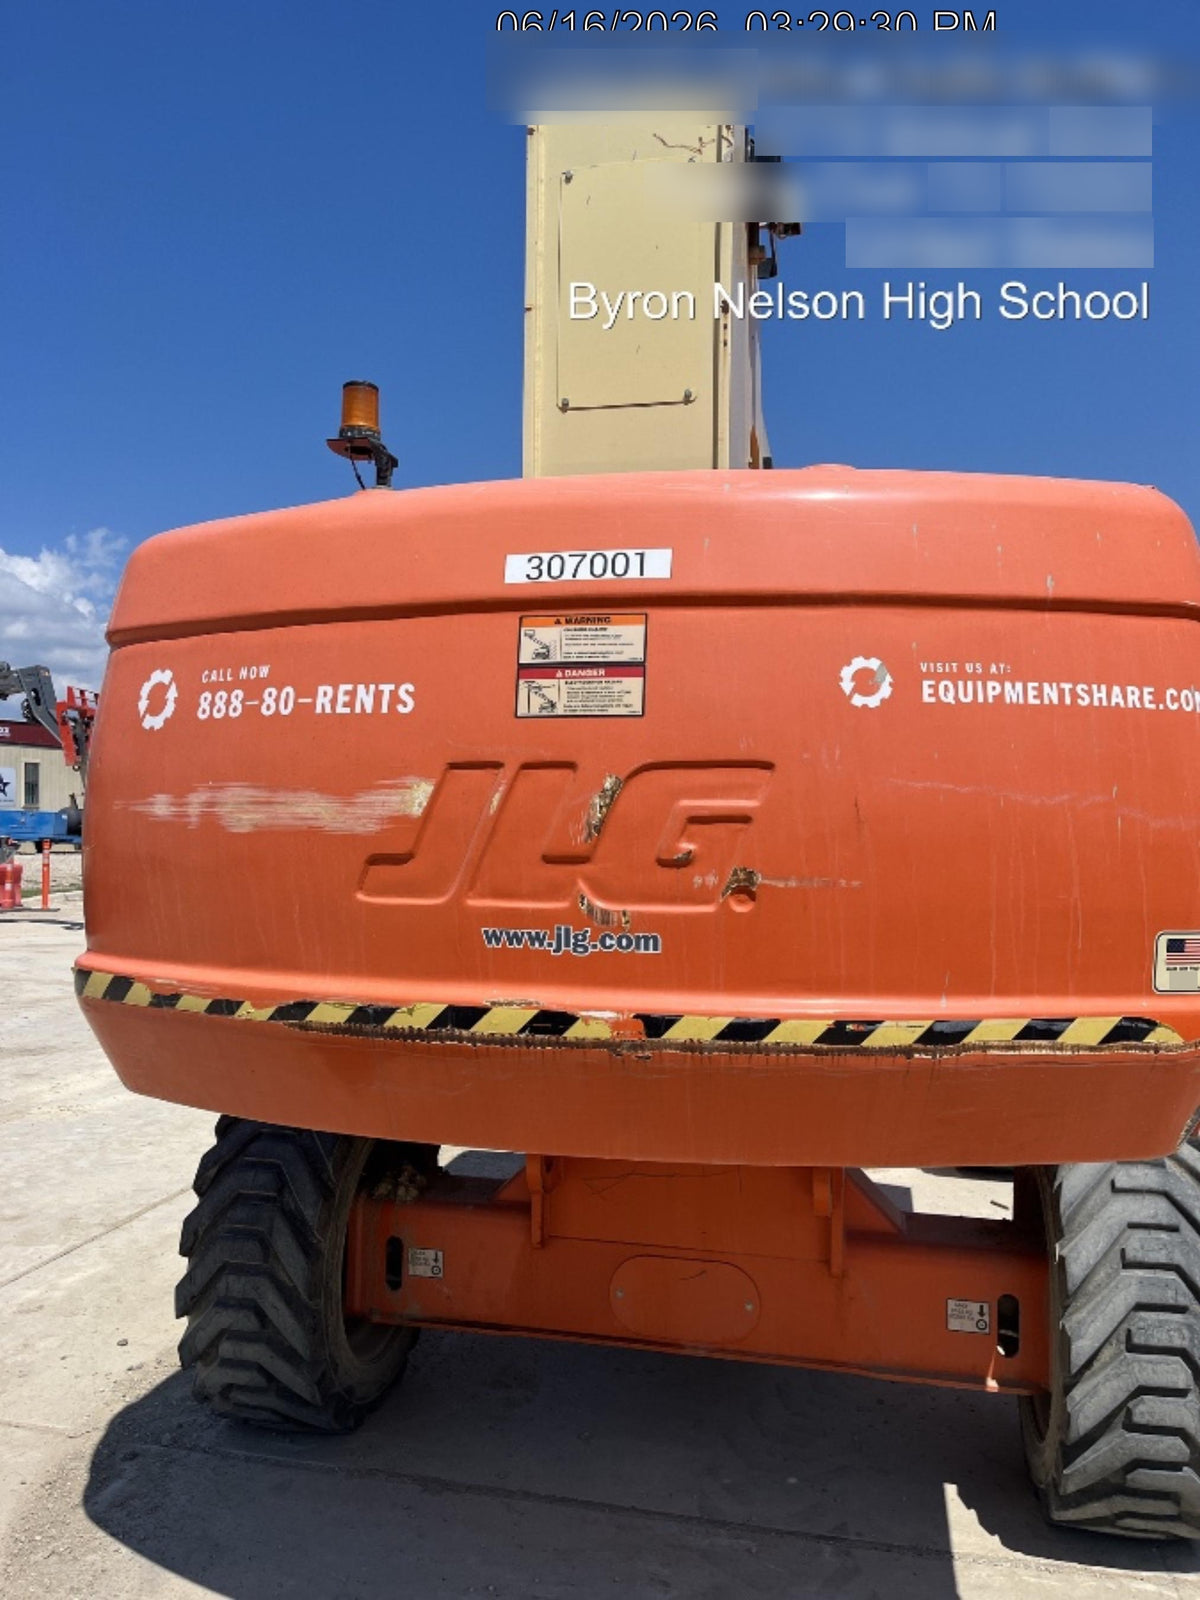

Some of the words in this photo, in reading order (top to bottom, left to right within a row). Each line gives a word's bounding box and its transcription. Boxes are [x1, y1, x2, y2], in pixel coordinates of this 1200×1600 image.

[526, 552, 646, 580] 307001
[201, 668, 234, 683] CALL
[239, 664, 271, 680] NOW
[920, 662, 958, 673] VISIT
[965, 662, 983, 674] US
[197, 682, 416, 720] 888-80-RENTS
[356, 761, 775, 913] JLG
[482, 926, 662, 956] www.jlg.com
